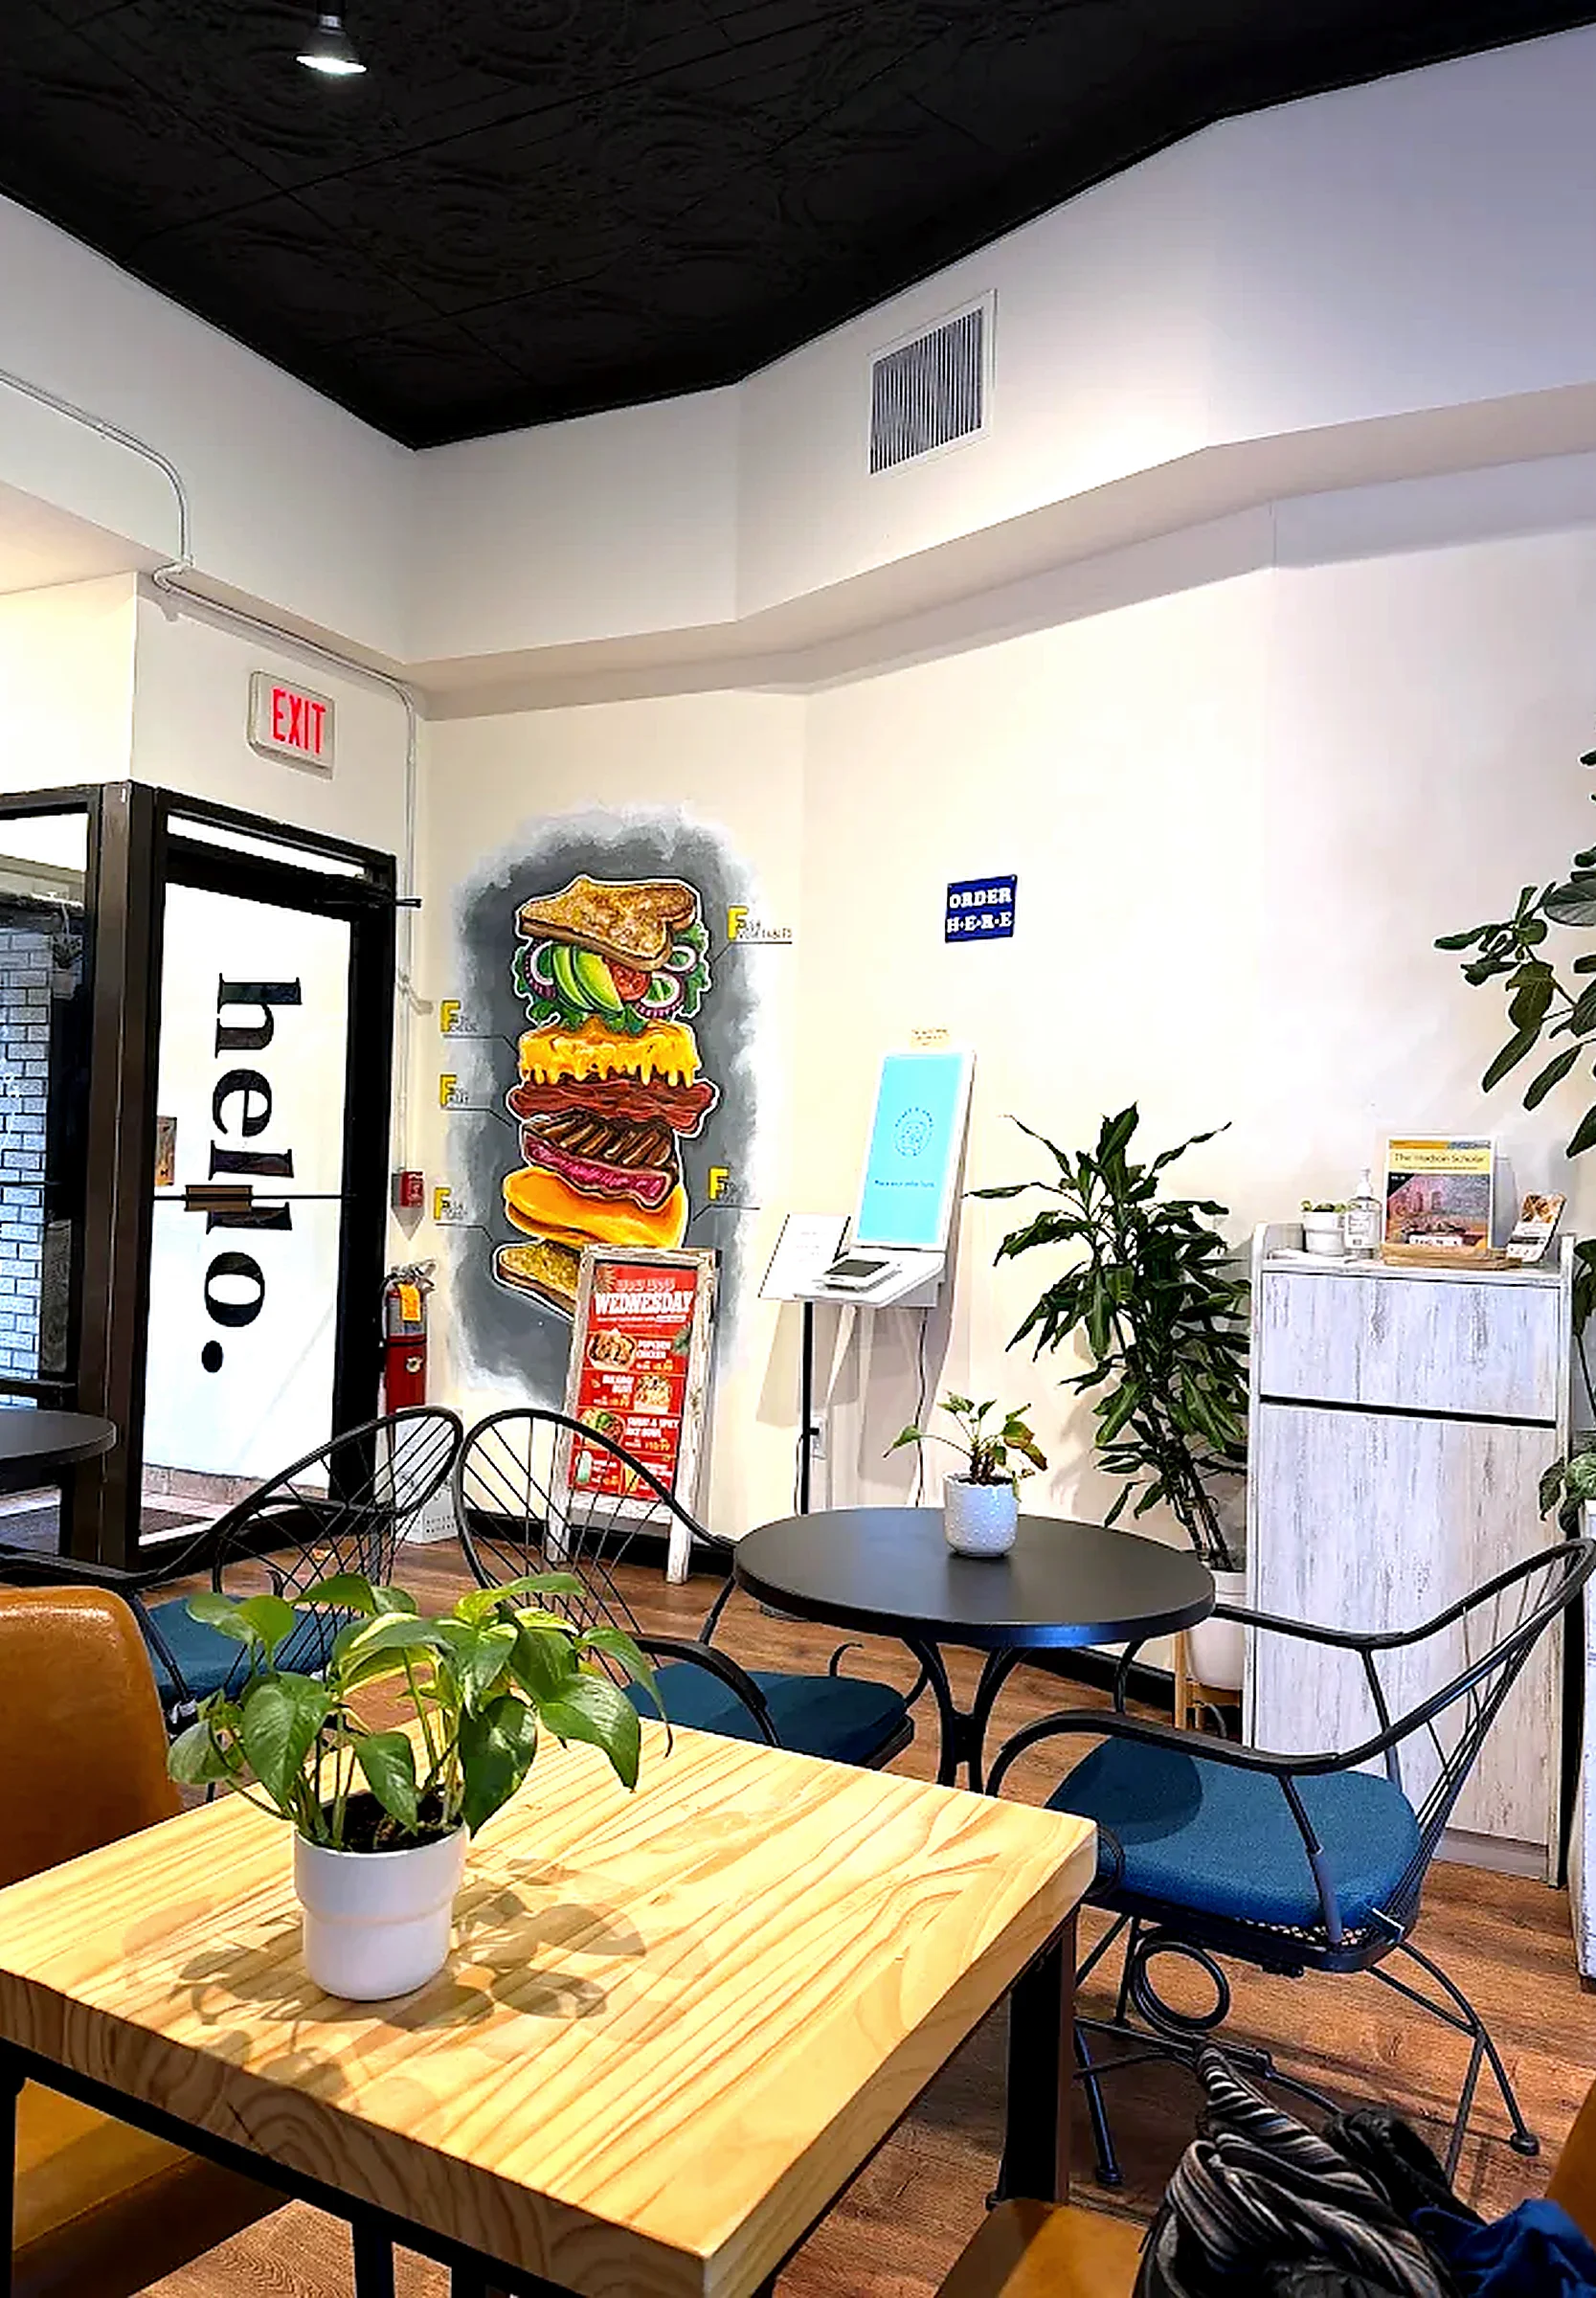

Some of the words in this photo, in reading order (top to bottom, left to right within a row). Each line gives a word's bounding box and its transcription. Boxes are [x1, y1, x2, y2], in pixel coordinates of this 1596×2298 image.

[272, 687, 326, 755] EXIT
[949, 887, 1012, 909] ORDER
[201, 973, 302, 1373] hello.
[595, 1291, 694, 1315] WEDNESDAY
